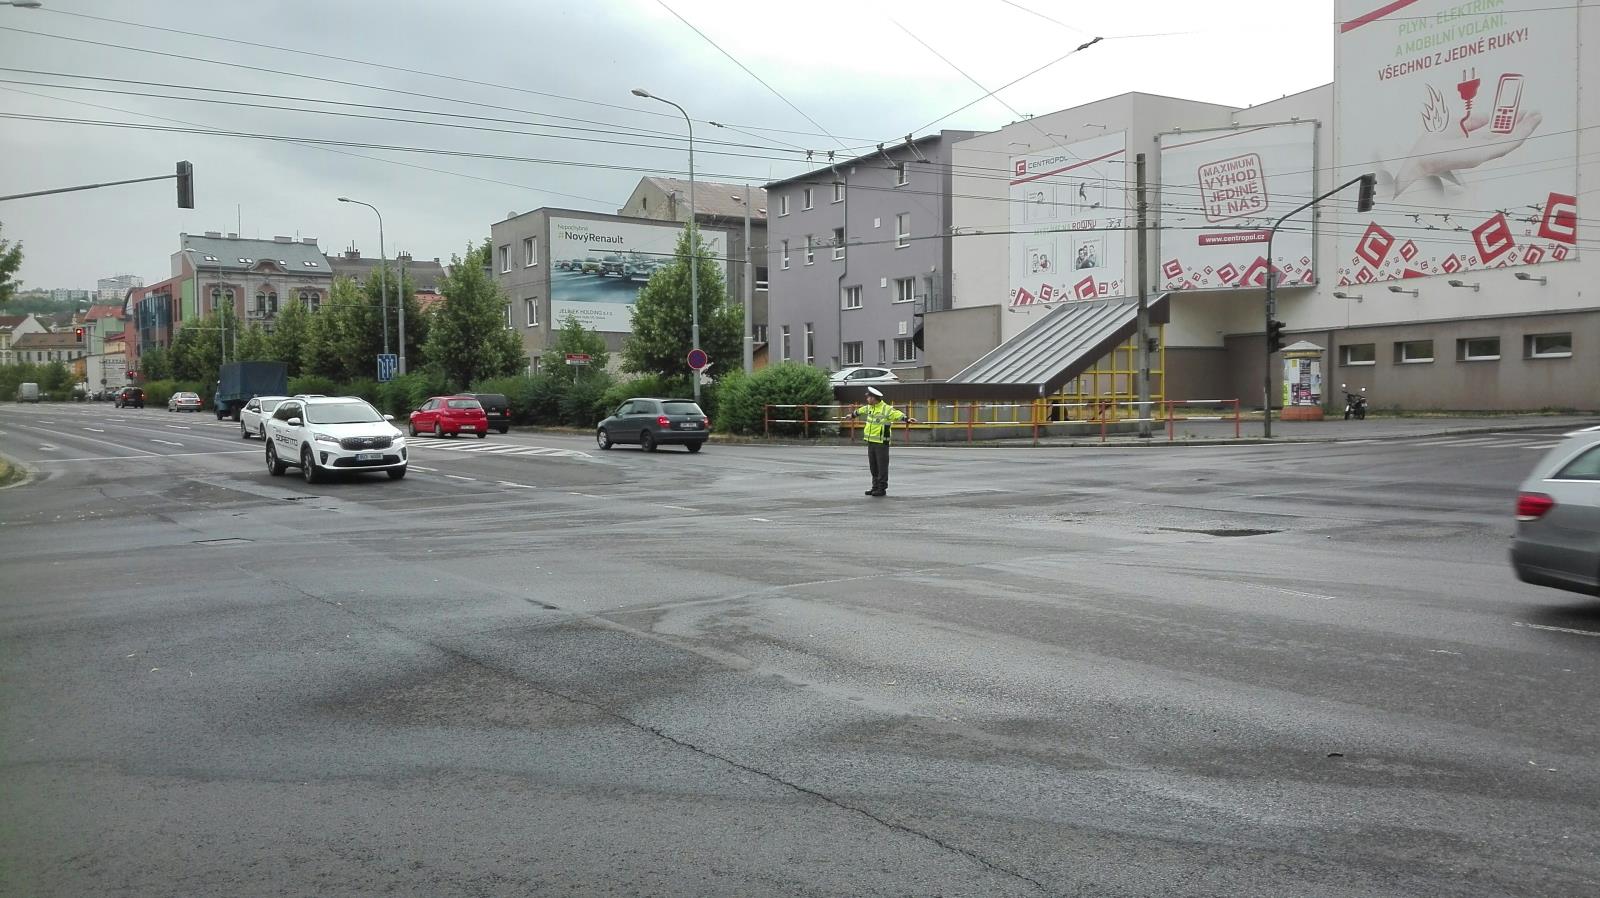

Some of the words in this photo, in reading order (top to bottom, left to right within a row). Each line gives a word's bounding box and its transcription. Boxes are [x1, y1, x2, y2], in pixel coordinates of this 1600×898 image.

[1378, 55, 1432, 81] VŠECHNO
[1434, 52, 1442, 66] Z
[1444, 36, 1485, 63] JEDNÉ
[1488, 27, 1529, 51] RUKY!
[1395, 44, 1403, 57] A
[1028, 155, 1069, 169] CENTROPOL
[1203, 157, 1254, 177] MAXIMUM
[1205, 168, 1257, 189] VÝHOD
[1211, 203, 1221, 216] U
[1228, 195, 1261, 213] NÁS
[1205, 233, 1265, 243] www.centropol.cz
